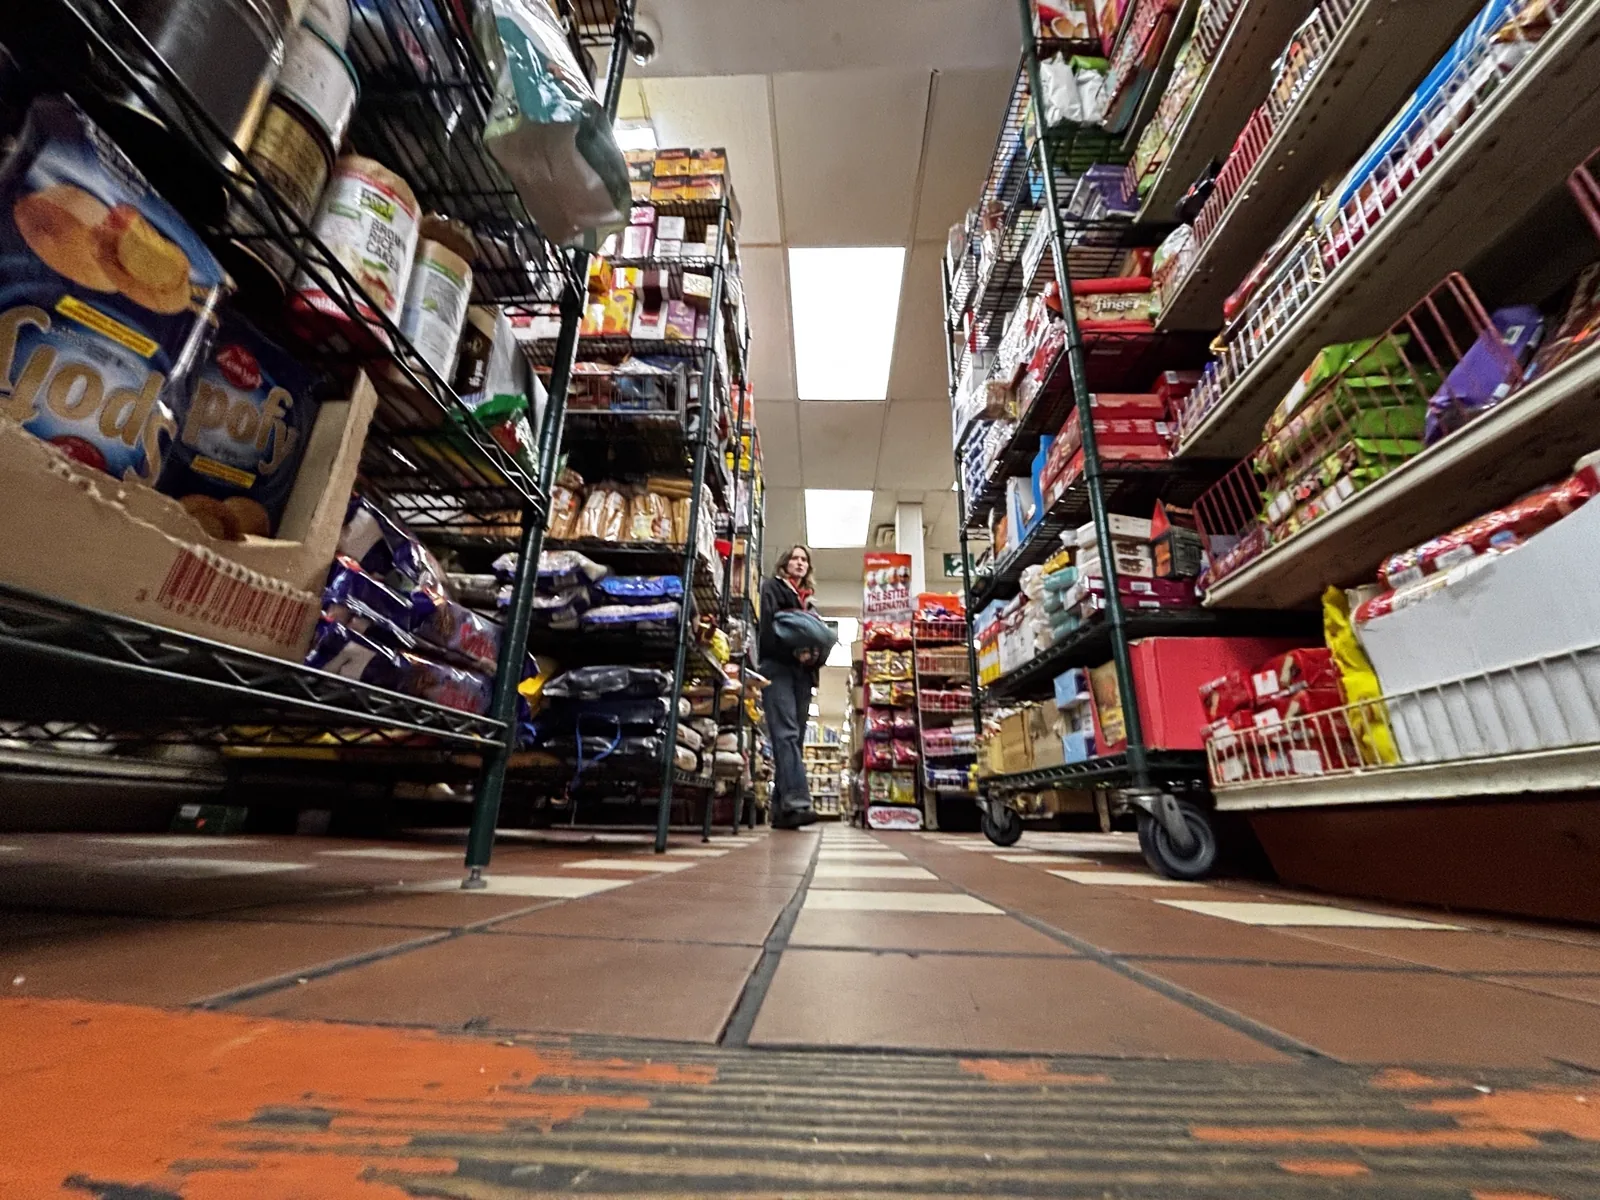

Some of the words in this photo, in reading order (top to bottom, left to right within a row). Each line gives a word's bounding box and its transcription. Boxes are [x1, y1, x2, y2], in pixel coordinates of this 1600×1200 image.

[951, 558, 965, 577] 2
[867, 592, 881, 602] THE
[883, 588, 909, 601] BETTER
[867, 599, 910, 612] ALTERNATIVE
